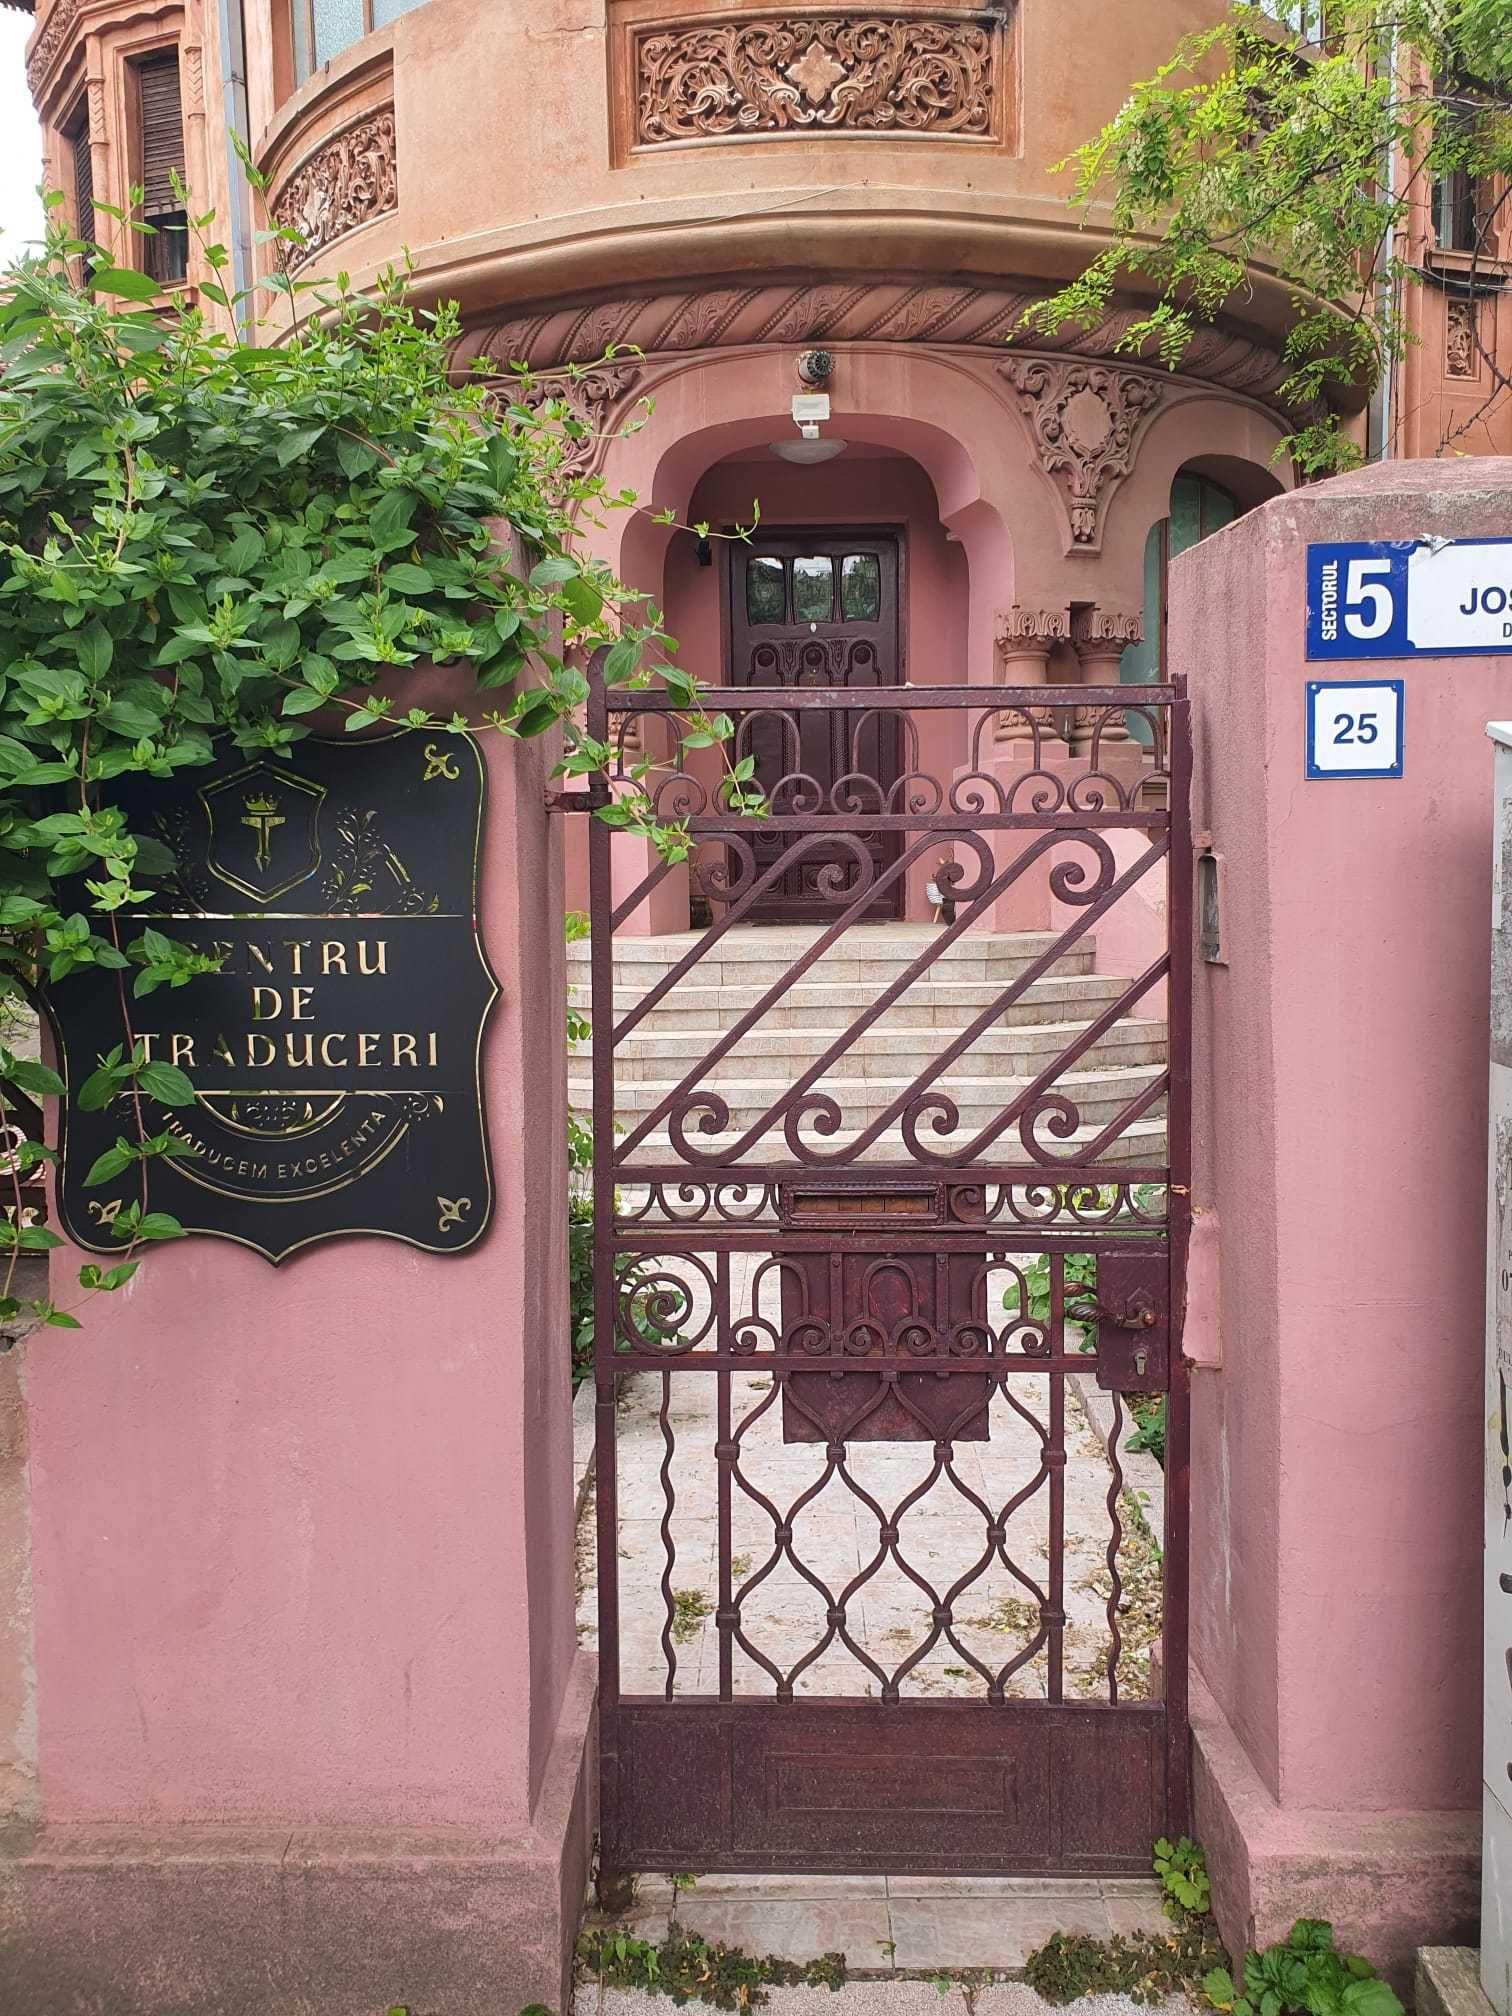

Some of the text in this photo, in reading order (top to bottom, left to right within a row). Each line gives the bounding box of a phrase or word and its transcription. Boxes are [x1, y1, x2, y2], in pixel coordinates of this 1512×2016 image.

[1321, 560, 1338, 641] SECTORUL
[1344, 558, 1394, 640] 5
[1459, 586, 1512, 616] JO
[1333, 712, 1378, 745] 25
[188, 940, 388, 975] ENTRU
[252, 986, 315, 1020] DE
[133, 1032, 438, 1067] TRADUCERI
